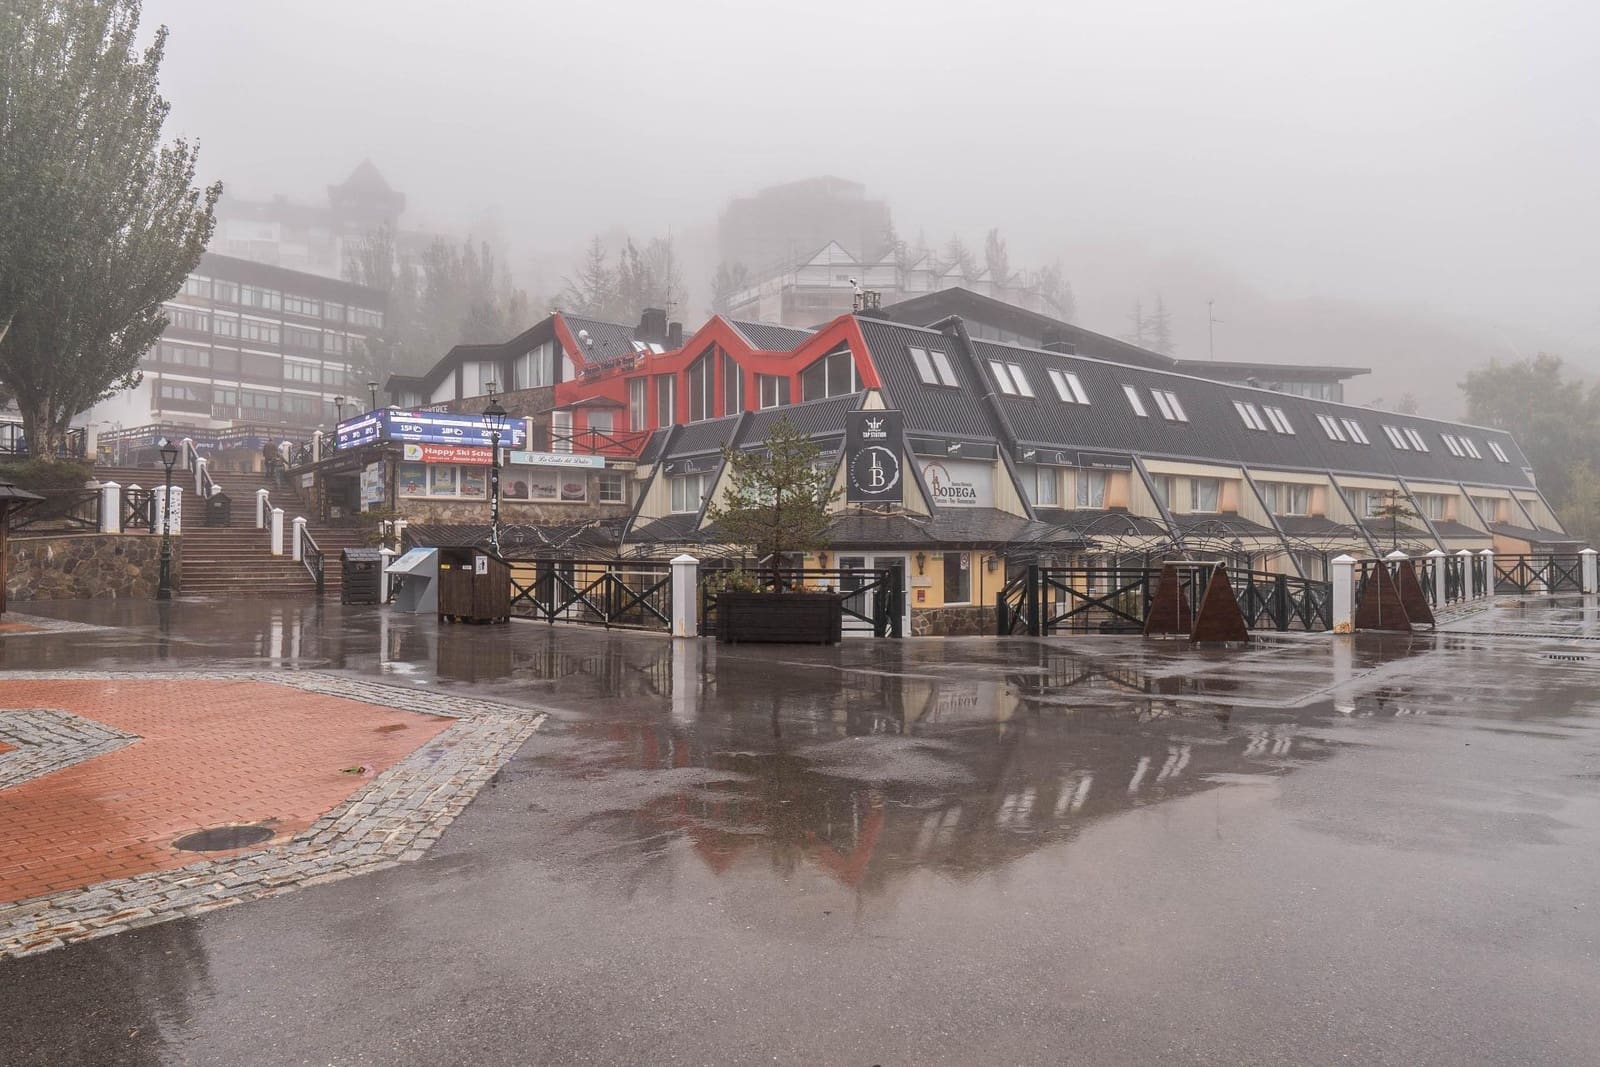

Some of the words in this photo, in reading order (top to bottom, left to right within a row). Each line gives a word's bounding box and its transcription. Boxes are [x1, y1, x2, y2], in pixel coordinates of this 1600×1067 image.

[424, 447, 454, 457] Happy
[456, 448, 470, 456] Ski
[471, 449, 494, 457] Scho
[932, 482, 977, 498] BODEGA
